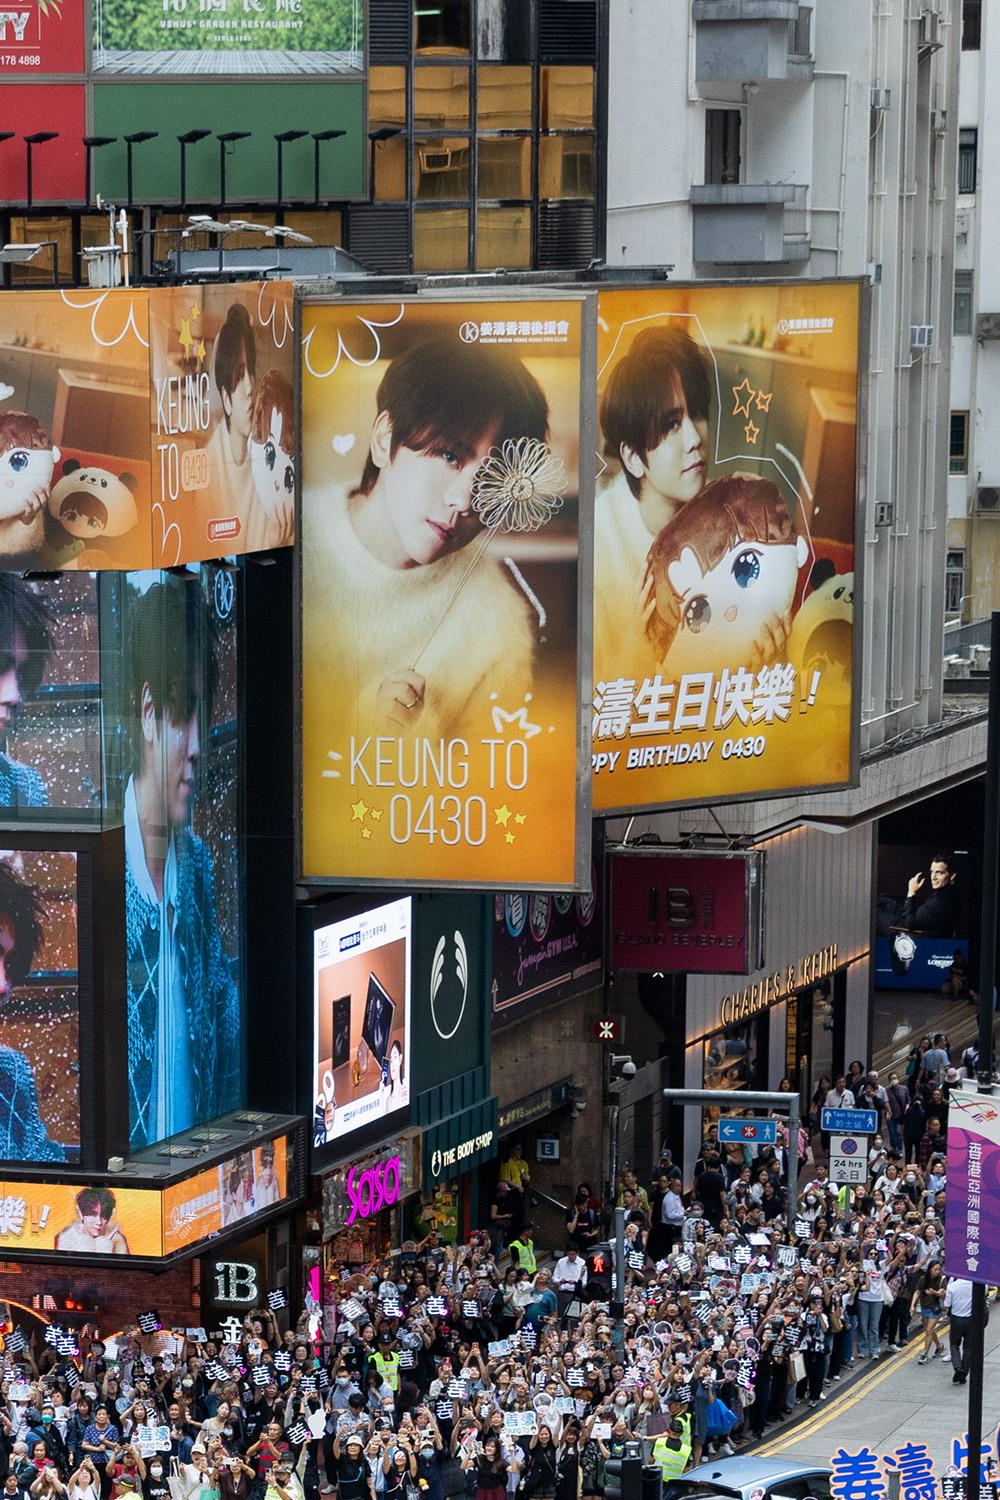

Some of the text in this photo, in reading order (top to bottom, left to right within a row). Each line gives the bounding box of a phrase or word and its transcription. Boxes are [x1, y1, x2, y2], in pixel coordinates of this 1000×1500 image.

[200, 20, 238, 29] GARDEN
[241, 20, 304, 29] RESTAURANT
[19, 56, 41, 66] 4898
[157, 373, 211, 436] KEUNG
[157, 442, 208, 501] TO 0430
[350, 736, 528, 790] KEUNG TO
[627, 741, 713, 770] BIRTHDAY
[722, 736, 766, 760] 0430
[389, 794, 487, 846] 0430
[673, 934, 744, 947] BEVERLEY
[720, 943, 840, 1028] CHARLES & KEITH
[833, 1110, 866, 1120] Taxi Stand
[835, 1120, 862, 1129] 的士站
[443, 1131, 493, 1163] THE BODY SHOP
[545, 1144, 551, 1154] E
[849, 1160, 863, 1168] hrs
[836, 1170, 860, 1180] 全日
[223, 1316, 243, 1344] 金
